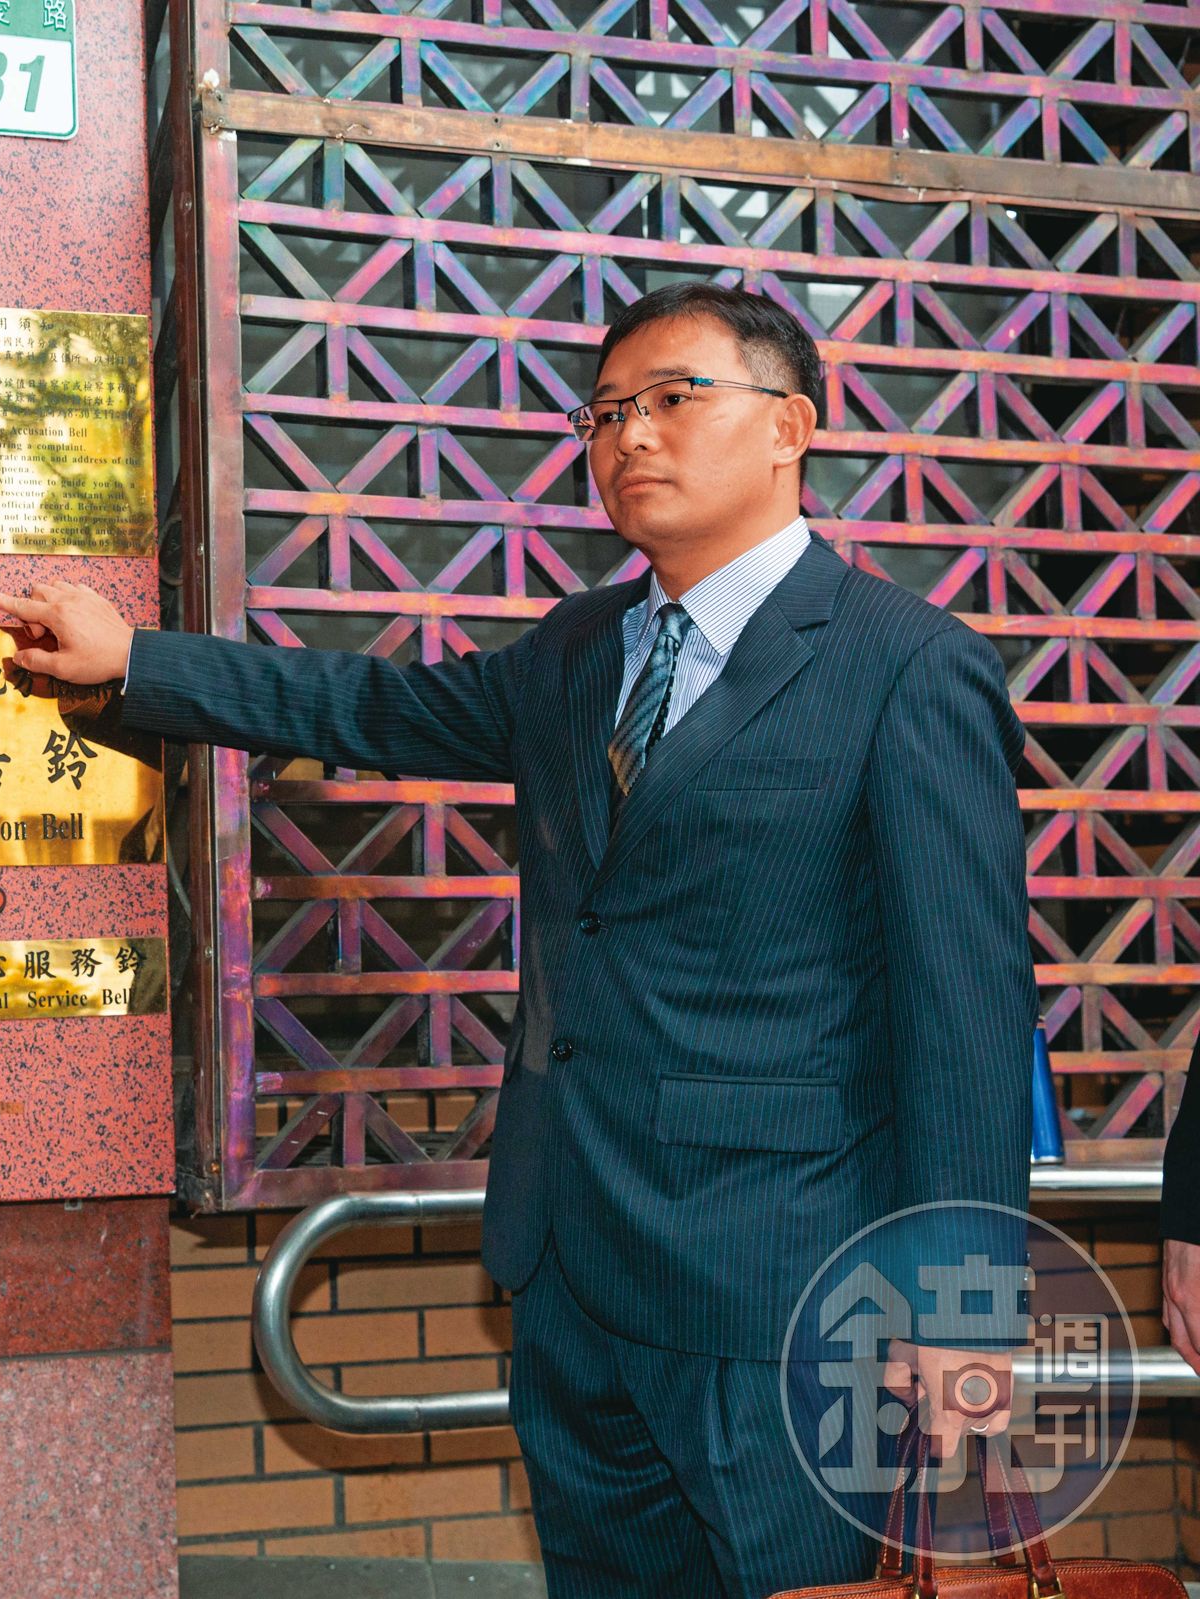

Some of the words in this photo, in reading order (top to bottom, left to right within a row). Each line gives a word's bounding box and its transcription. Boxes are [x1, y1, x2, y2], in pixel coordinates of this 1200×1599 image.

[11, 425, 64, 437] Accusation
[69, 427, 88, 438] Bell
[36, 443, 87, 453] complaint.
[21, 454, 46, 462] name
[50, 455, 67, 463] and
[72, 456, 108, 464] address
[111, 456, 121, 464] of
[47, 478, 57, 486] to
[61, 479, 86, 489] guide
[93, 481, 110, 490] you
[62, 491, 103, 500] assistant
[108, 492, 125, 500] will
[1, 500, 35, 510] official
[40, 501, 73, 511] record.
[78, 502, 107, 512] Before
[112, 503, 127, 512] the
[4, 513, 19, 521] not
[24, 513, 48, 522] leave
[52, 514, 87, 523] without
[8, 525, 28, 534] only
[34, 525, 44, 533] be
[50, 526, 90, 536] accepted
[24, 536, 47, 546] from
[41, 812, 85, 841] Bell
[27, 989, 88, 1008] Service
[102, 988, 134, 1006] Bell
